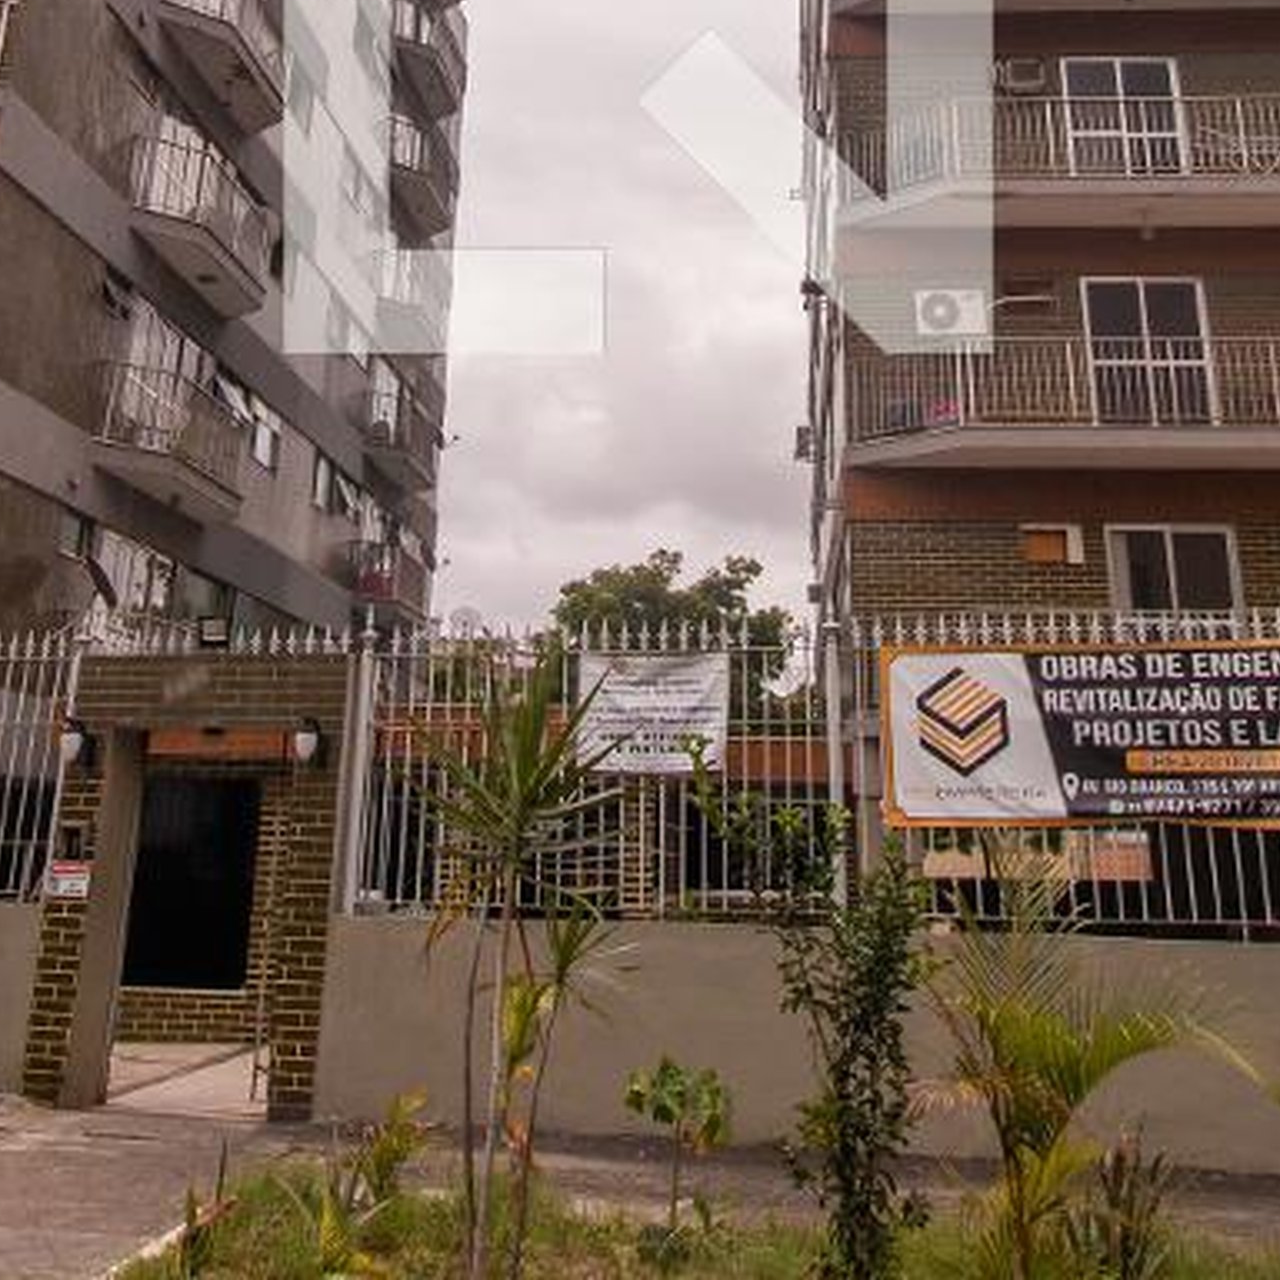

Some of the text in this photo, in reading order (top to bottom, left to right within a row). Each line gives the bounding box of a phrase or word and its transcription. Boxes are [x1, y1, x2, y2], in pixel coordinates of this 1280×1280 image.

[1040, 654, 1138, 681] OBRAS
[1145, 653, 1184, 678] DE
[1042, 683, 1222, 713] REVITALIZAÇÃO
[1228, 686, 1261, 711] DE
[1074, 720, 1222, 746] PROJETOS
[1230, 719, 1251, 745] E
